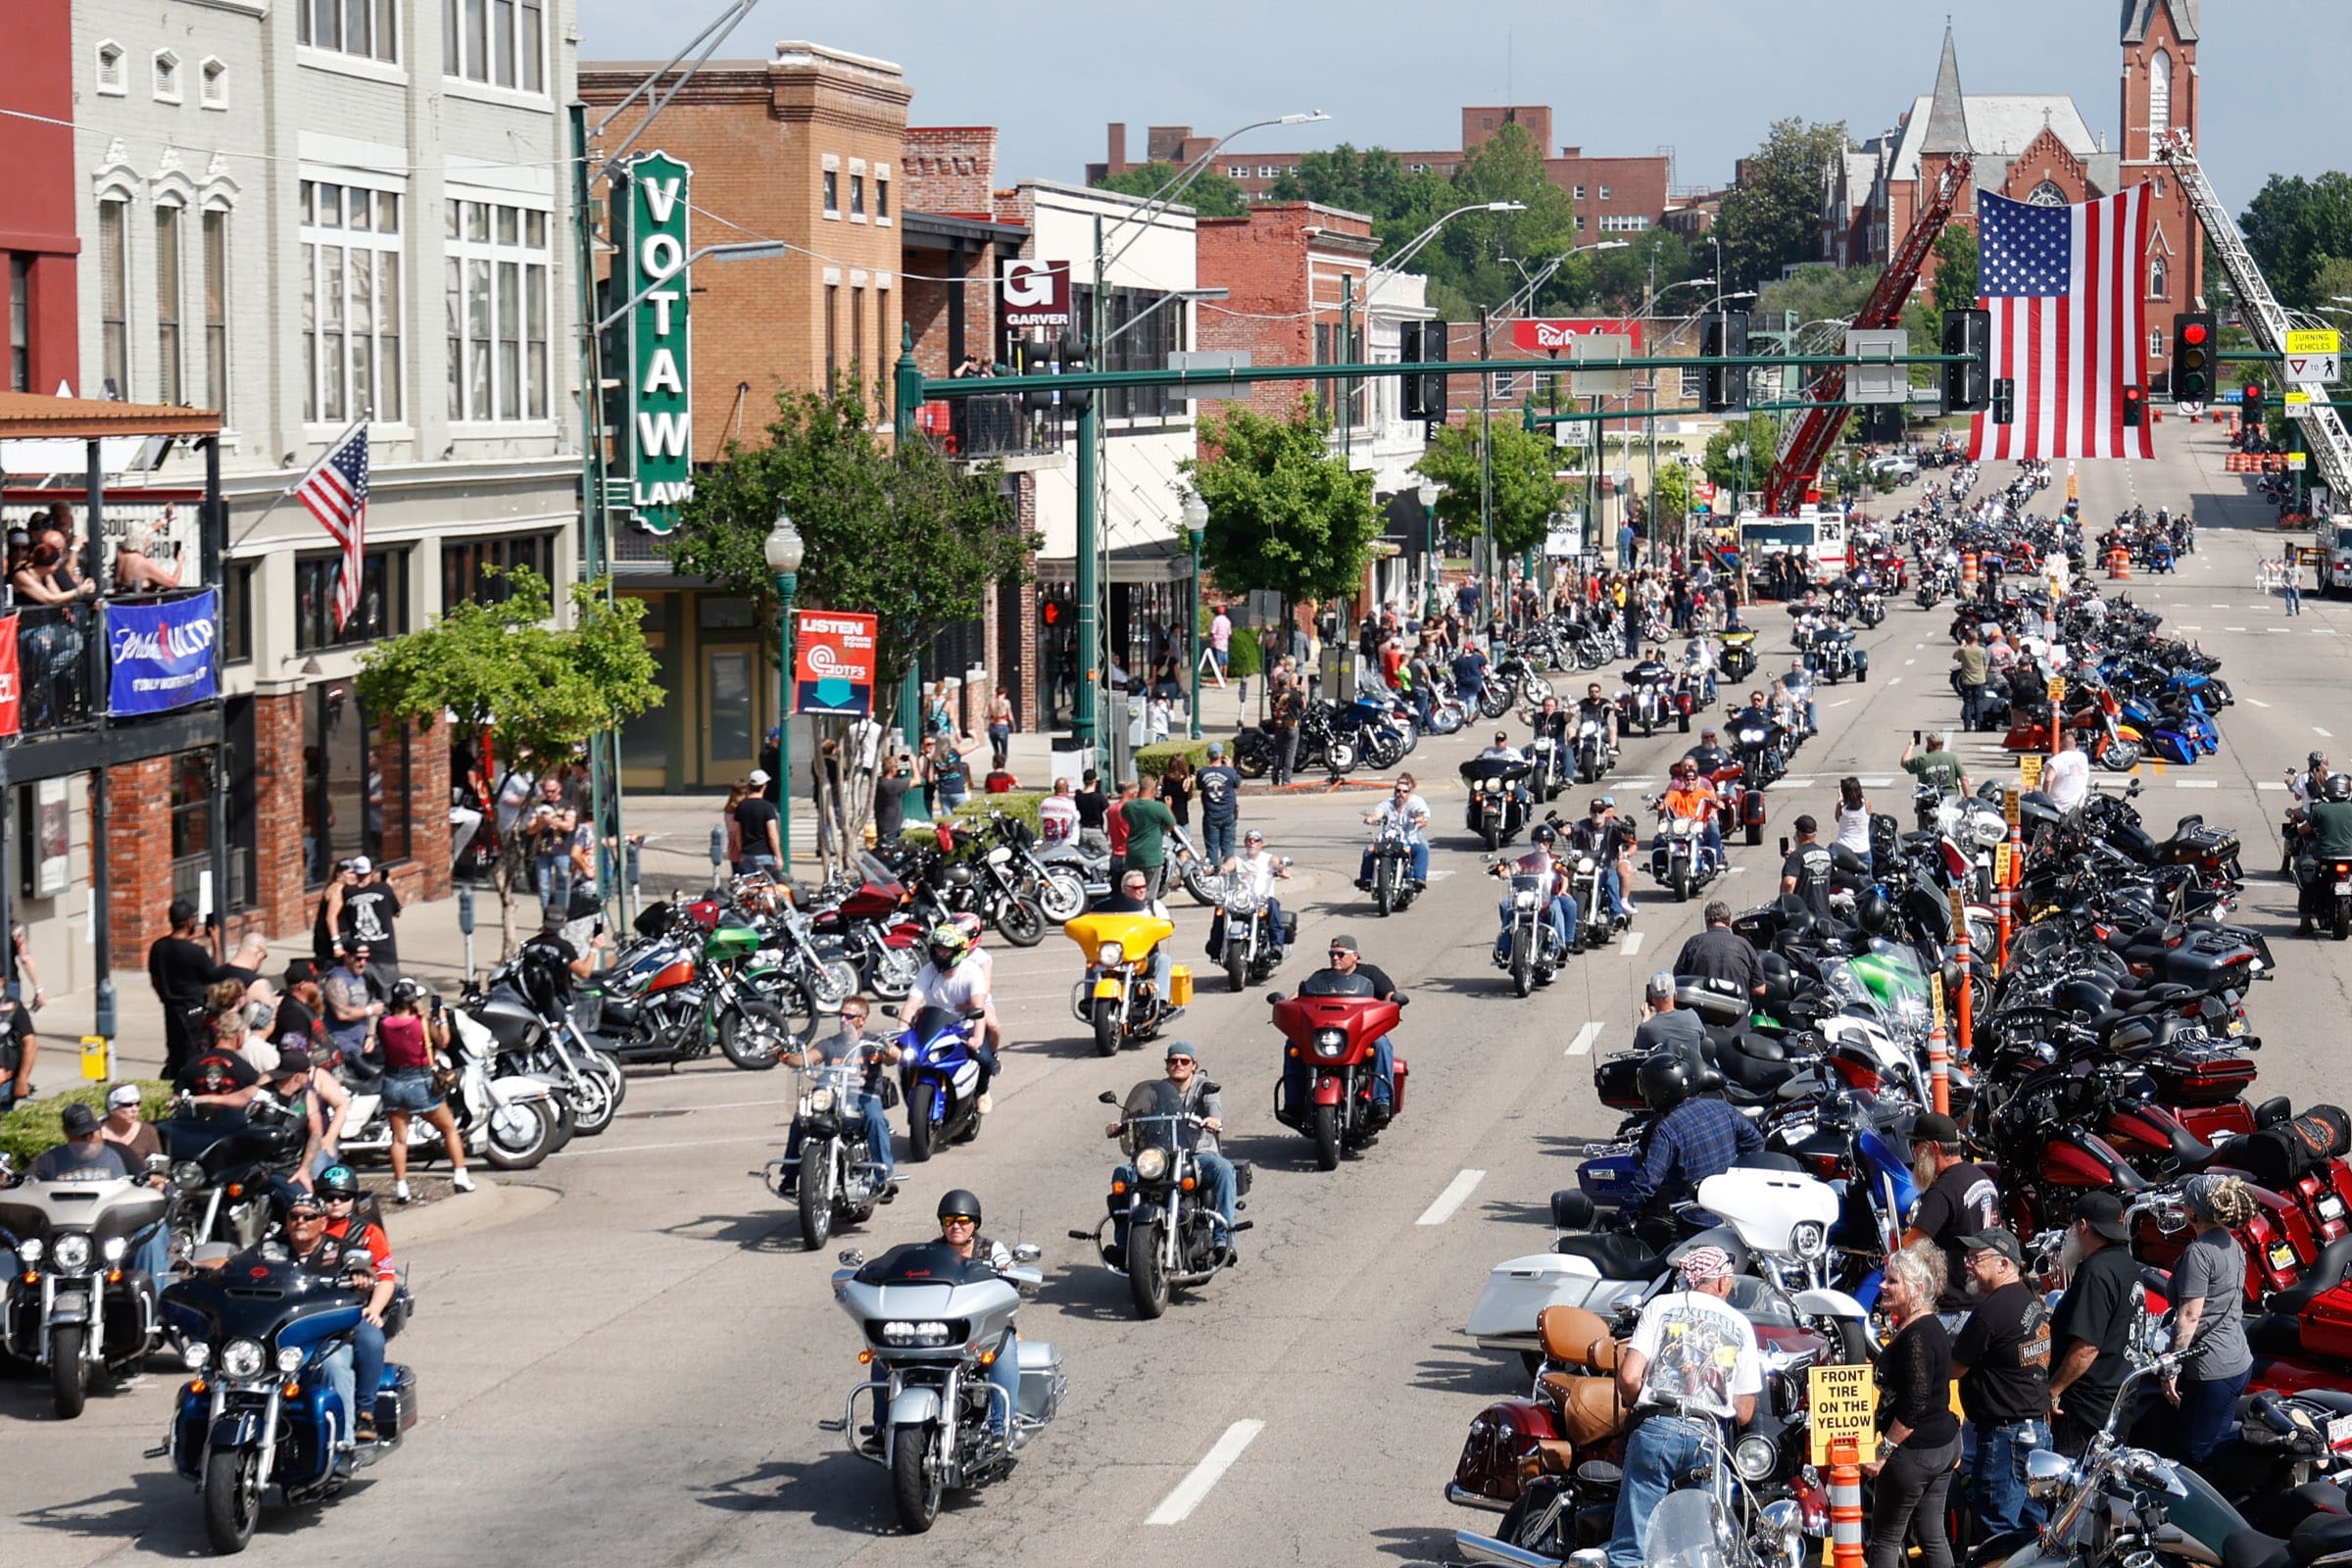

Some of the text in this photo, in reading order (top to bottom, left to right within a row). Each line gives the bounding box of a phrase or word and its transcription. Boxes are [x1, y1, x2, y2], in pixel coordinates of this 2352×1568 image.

[637, 176, 689, 458] VOTAW
[1006, 314, 1068, 325] GARVER
[633, 481, 694, 506] LAW
[801, 618, 864, 635] LISTEN
[835, 664, 865, 676] DTFS
[1044, 818, 1069, 841] 21
[1821, 1370, 1865, 1383] FRONT
[1829, 1386, 1858, 1397] TIRE
[1819, 1400, 1868, 1413] ON THE
[1818, 1415, 1871, 1429] YELLOW
